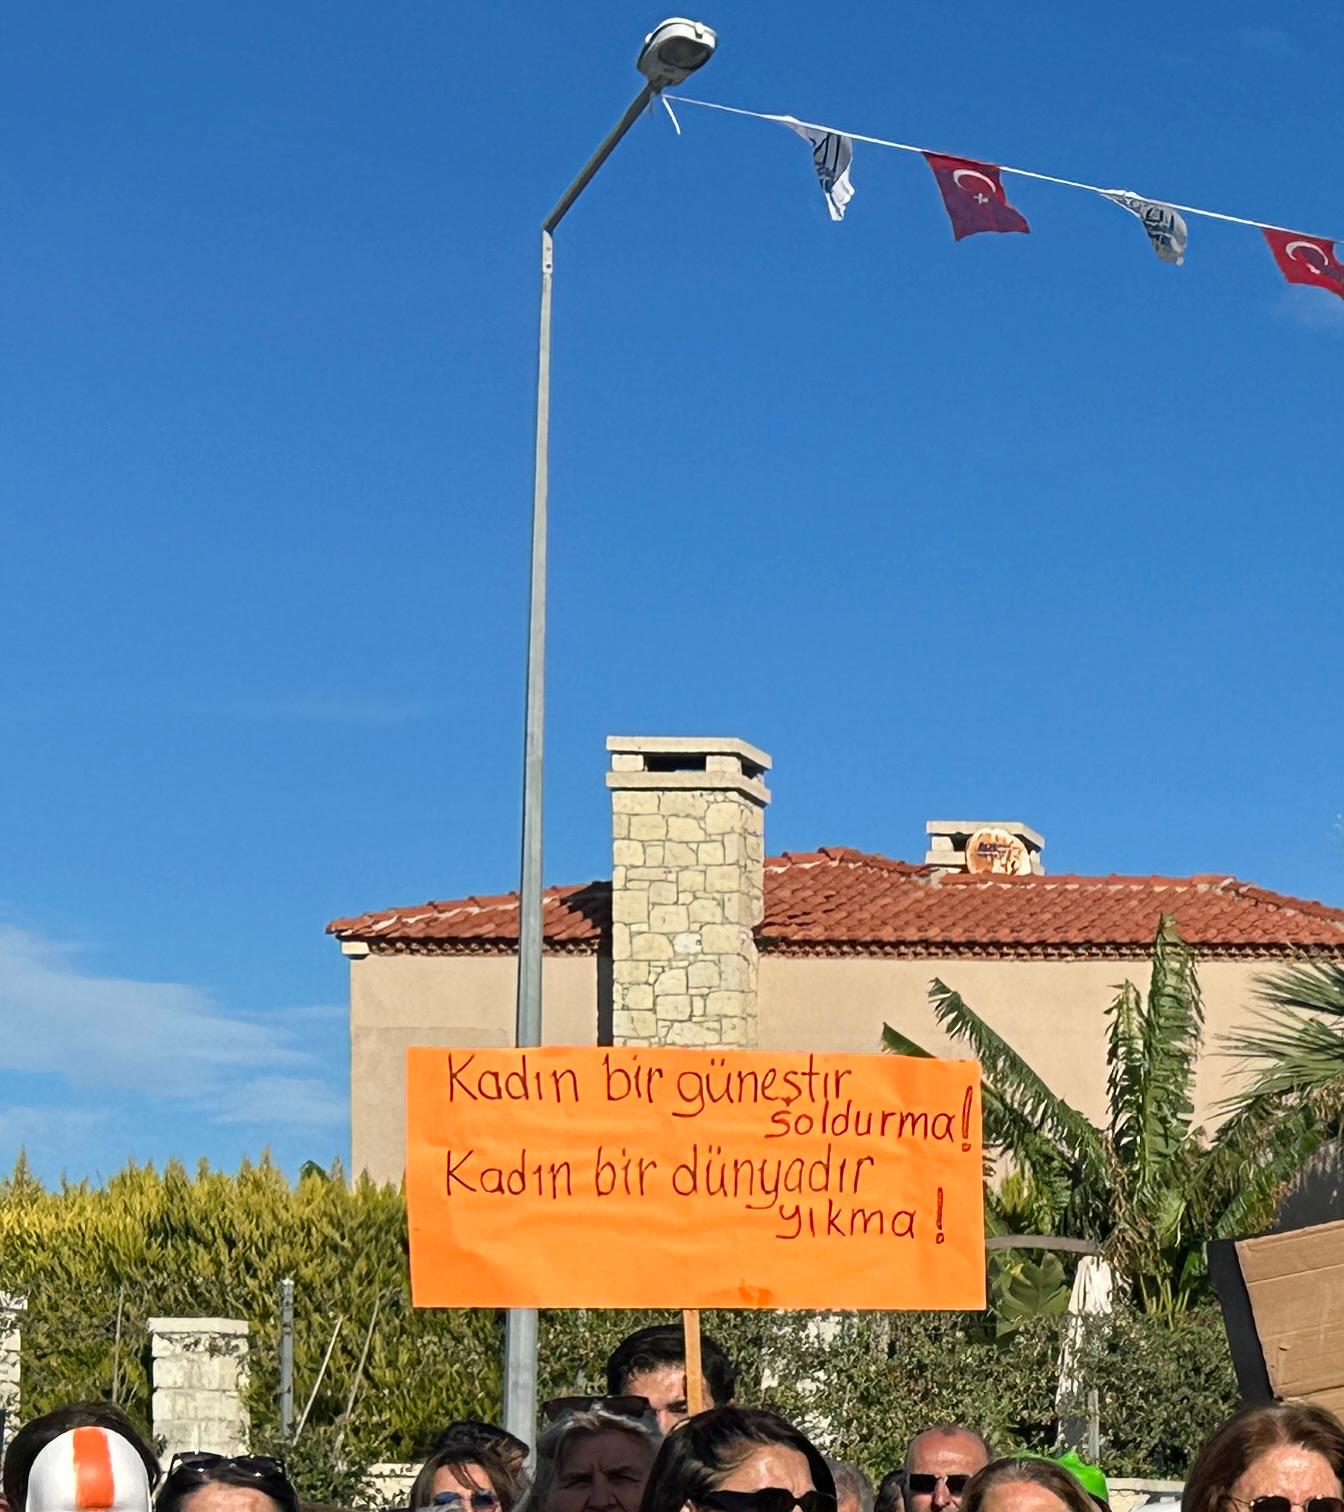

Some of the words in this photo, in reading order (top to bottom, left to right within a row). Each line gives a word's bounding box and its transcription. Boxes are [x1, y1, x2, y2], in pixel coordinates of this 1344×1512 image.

[447, 1054, 580, 1104] Kadın
[602, 1053, 664, 1104] bir
[446, 1149, 572, 1198] Kadın
[594, 1146, 657, 1197] bir
[671, 1143, 875, 1210] dünyadır
[775, 1199, 917, 1239] yıkma
